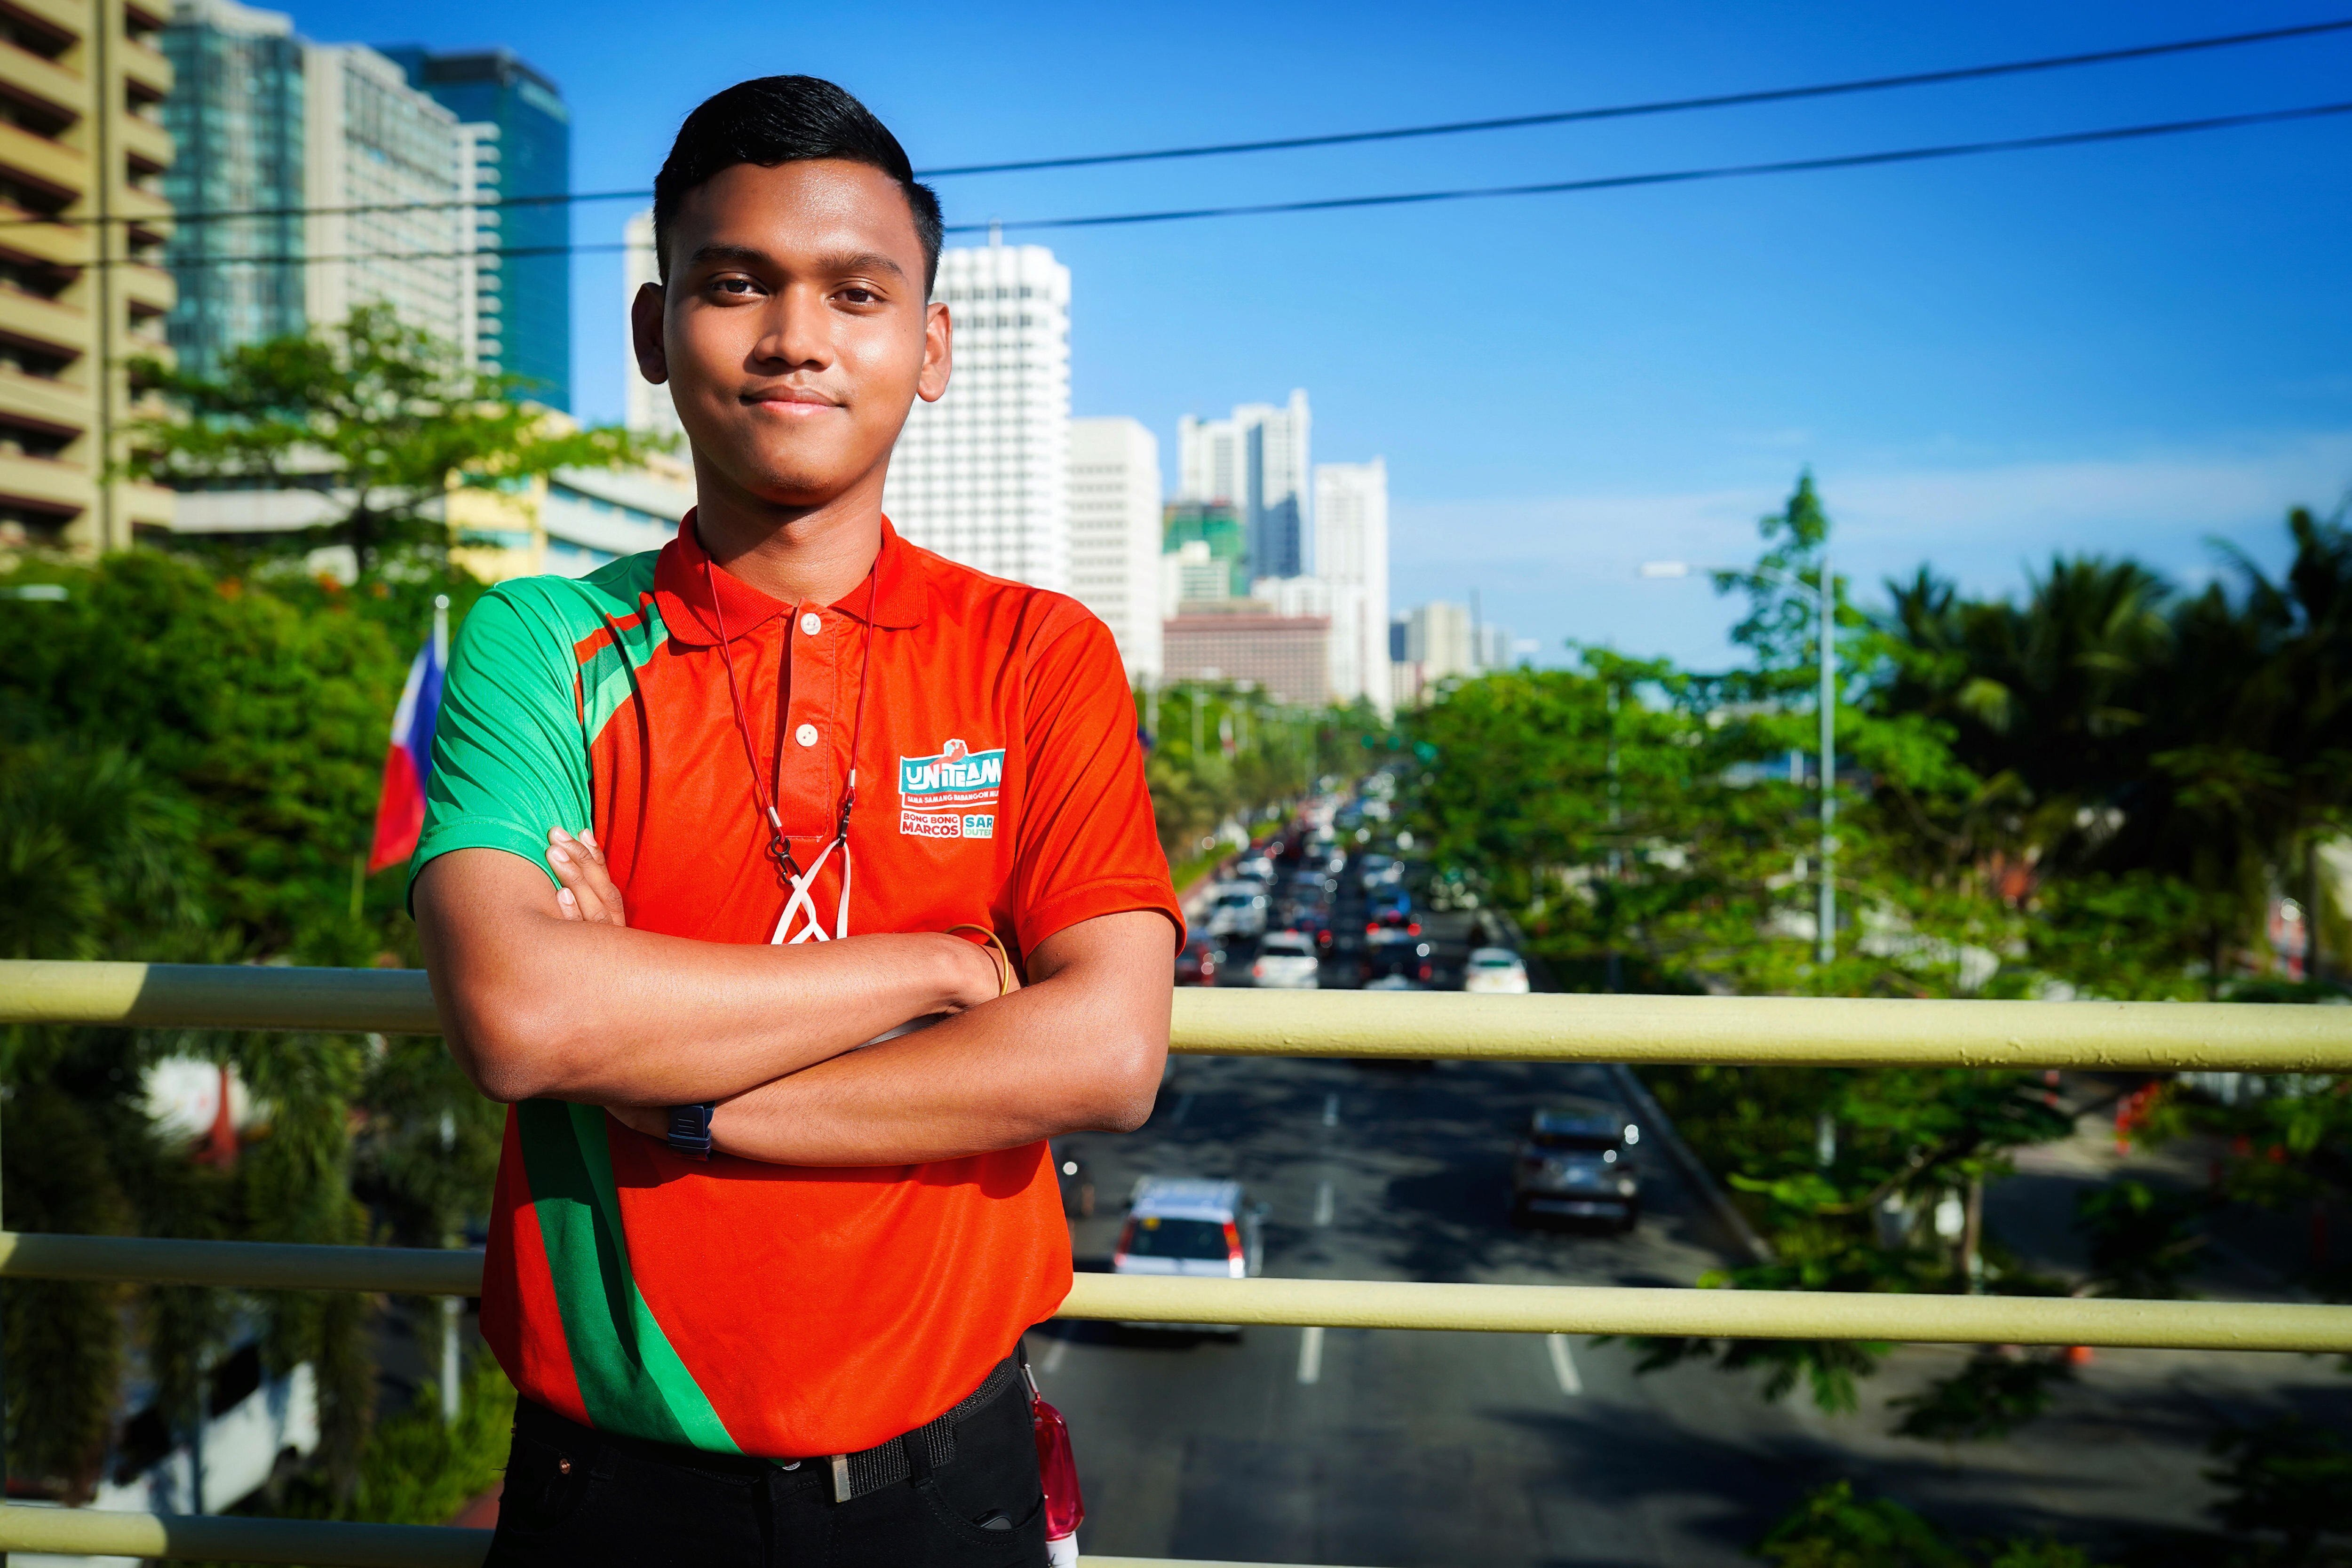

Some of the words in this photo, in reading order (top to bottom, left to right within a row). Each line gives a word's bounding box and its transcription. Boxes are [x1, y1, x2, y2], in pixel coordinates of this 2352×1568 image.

[906, 758, 1001, 790] UNITEAM
[904, 813, 928, 823] BONG
[902, 821, 958, 835] MARCOS
